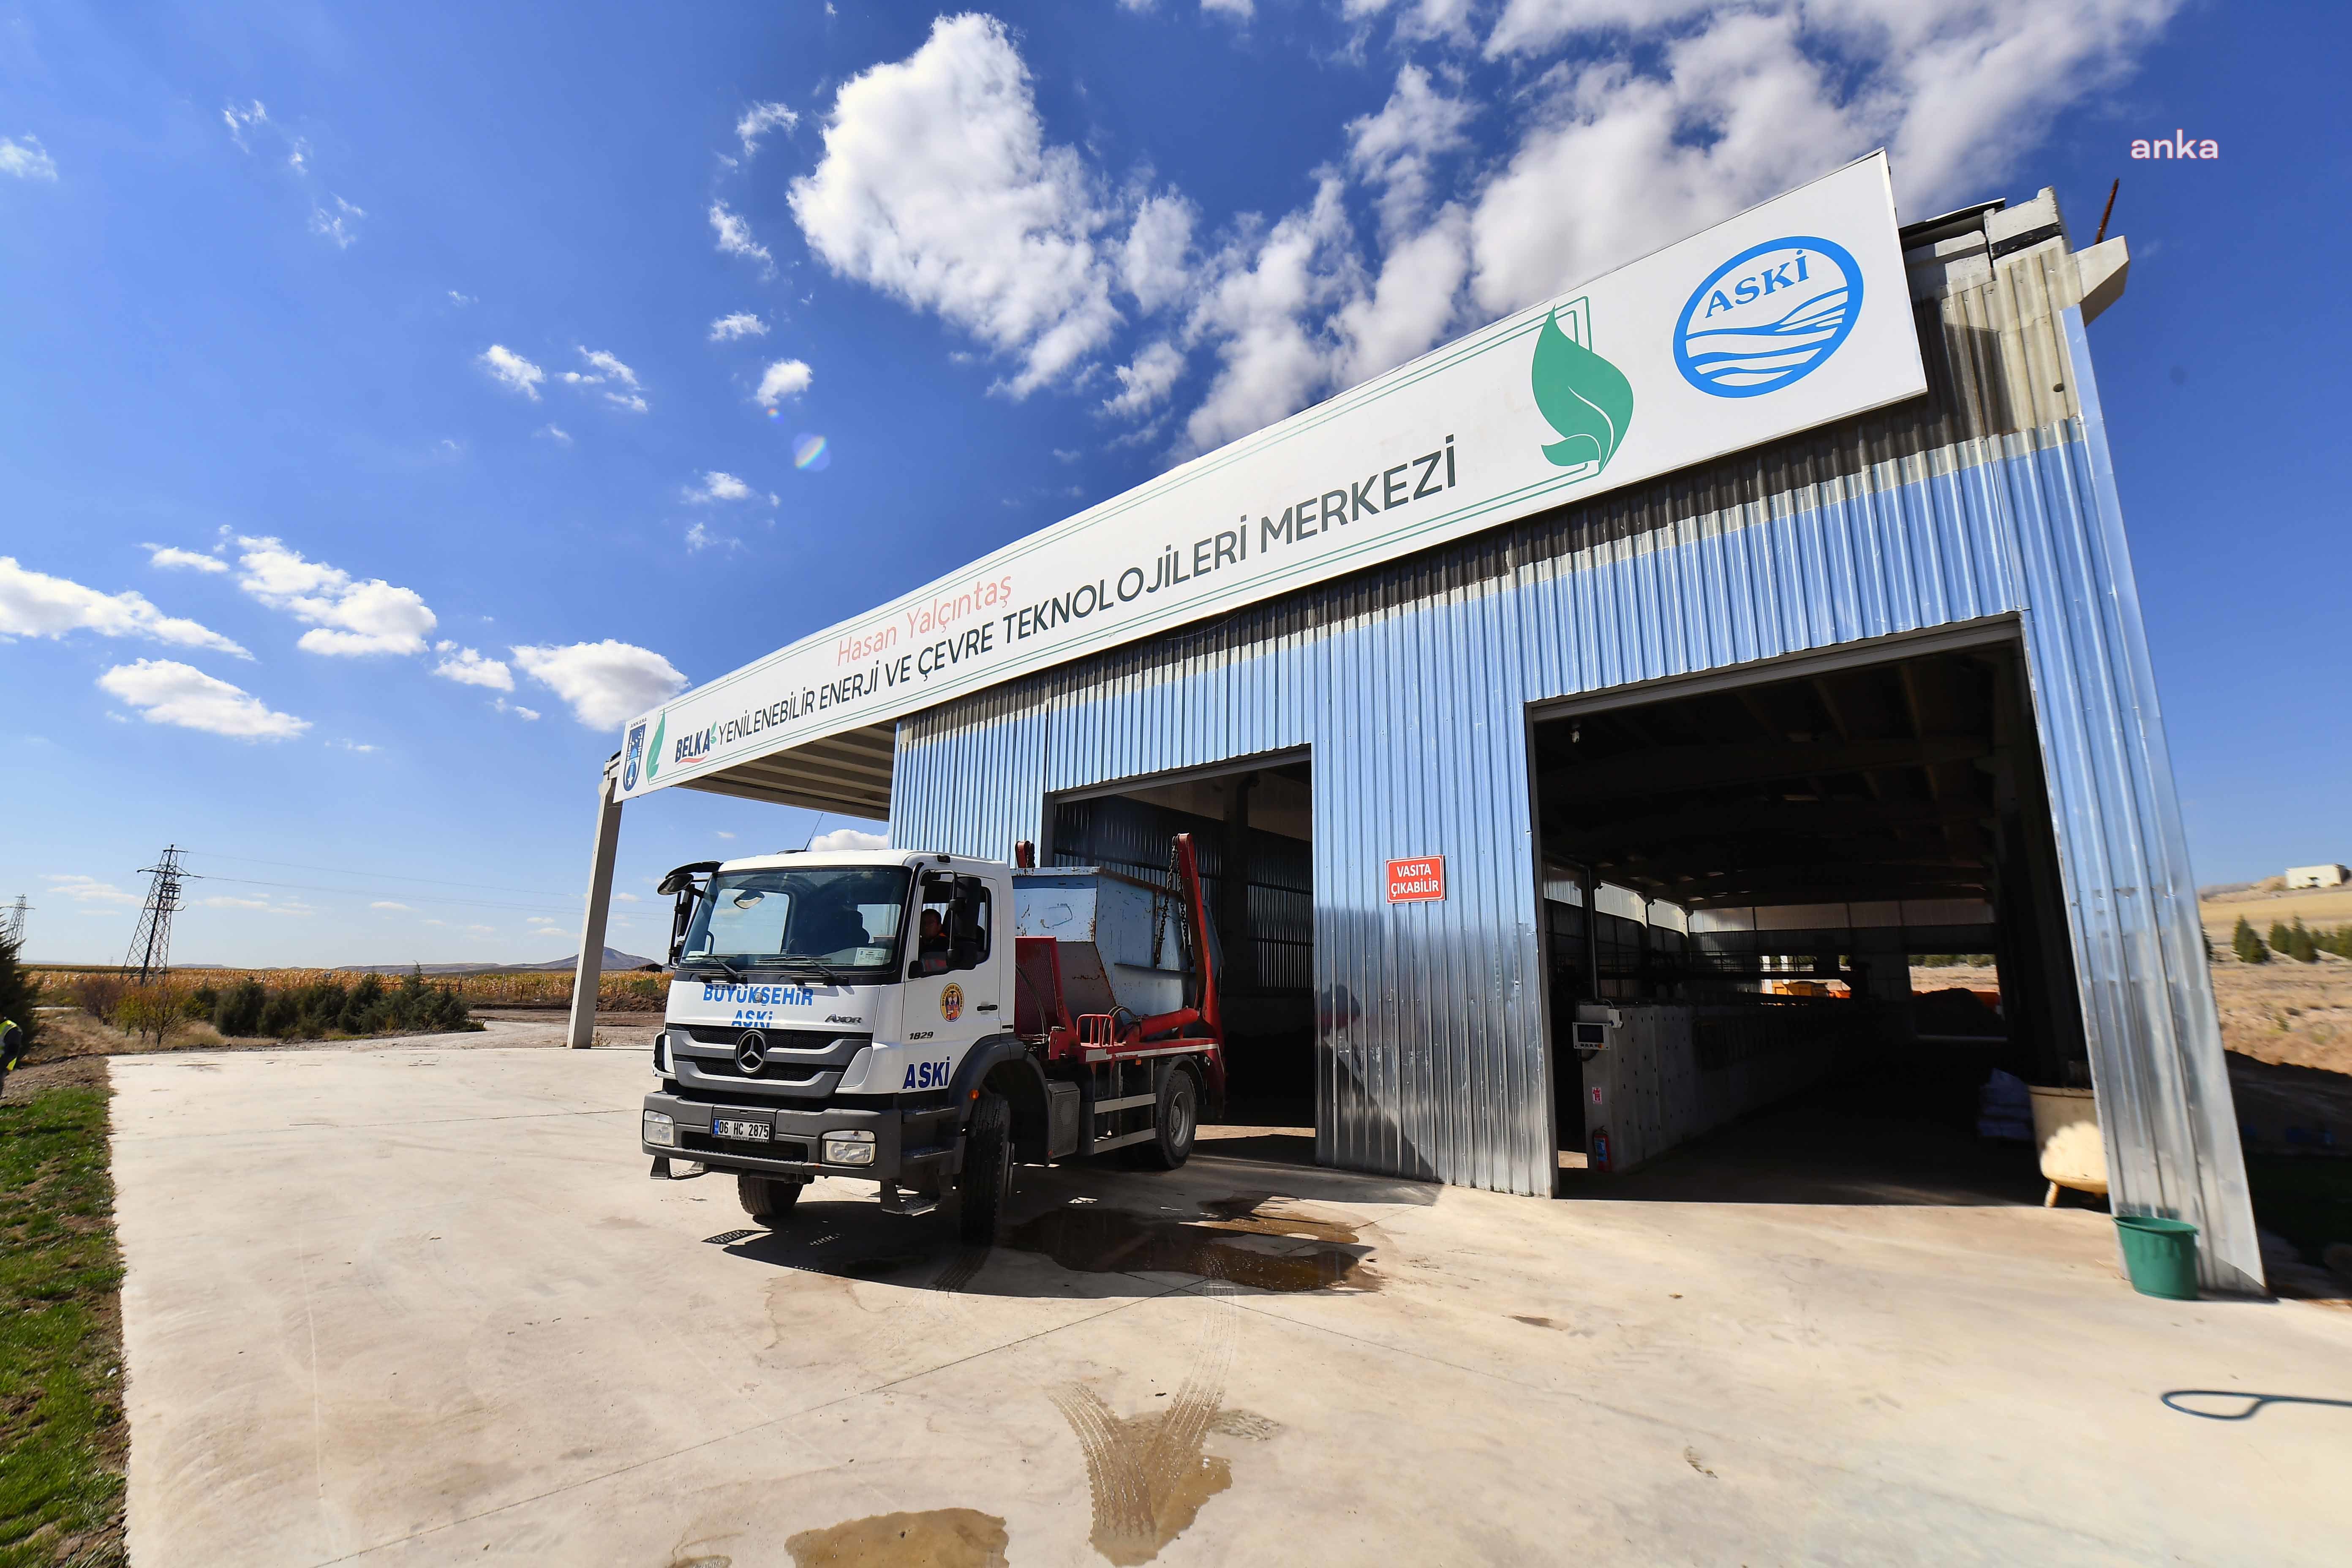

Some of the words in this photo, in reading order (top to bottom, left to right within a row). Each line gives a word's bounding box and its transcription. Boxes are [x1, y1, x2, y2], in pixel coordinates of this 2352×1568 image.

[1705, 250, 1809, 318] ASKİ
[719, 687, 815, 745] YENİLENEBİLİR
[819, 660, 879, 710] ENERJİ
[885, 655, 912, 687] VE
[918, 622, 994, 681] ÇEVRE
[1003, 514, 1247, 643] TEKNOLOJİLERİ
[1261, 434, 1456, 553] MERKEZİ
[838, 626, 897, 667] Hasan
[907, 576, 1011, 638] Yalçıntaş
[630, 717, 647, 728] ANKARA
[675, 728, 710, 763] BELKA
[1396, 864, 1432, 877] VASITA
[1391, 878, 1440, 897] ÇIKABİLİR
[909, 1032, 934, 1040] 1829
[902, 1056, 950, 1089] ASKİ
[719, 1122, 729, 1133] 06
[733, 1122, 743, 1135] HC
[749, 1124, 769, 1138] 2875
